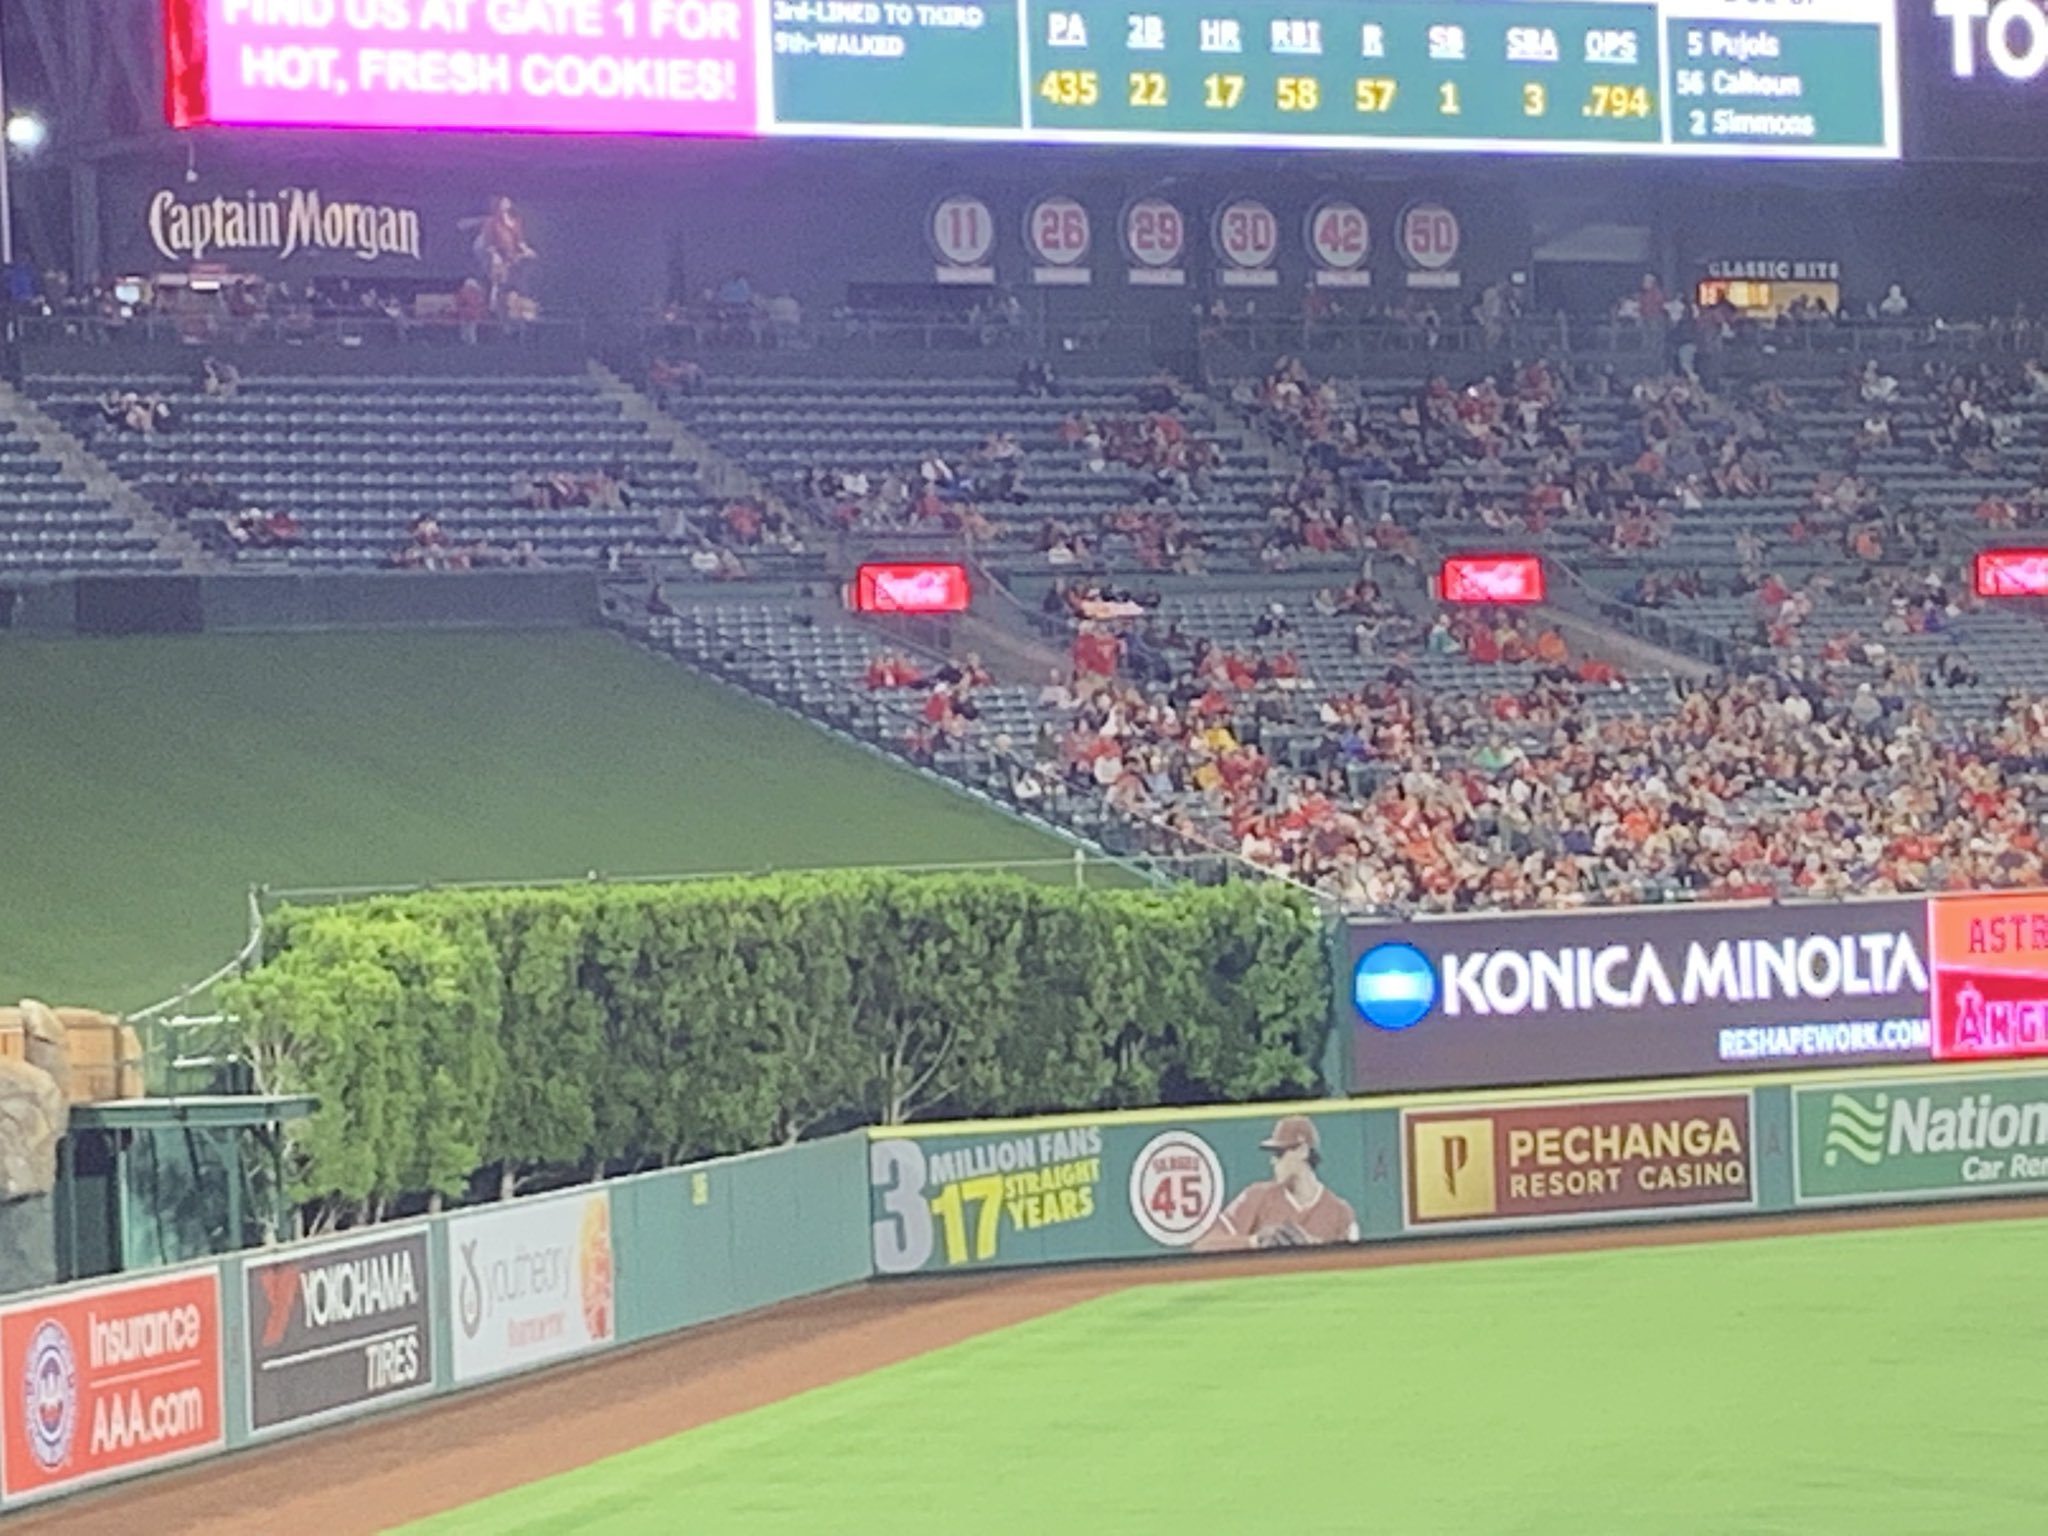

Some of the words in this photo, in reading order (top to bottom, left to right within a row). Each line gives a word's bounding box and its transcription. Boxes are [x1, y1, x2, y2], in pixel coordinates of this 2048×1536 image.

[222, 0, 335, 28] FIND
[345, 0, 411, 32] US
[417, 0, 481, 33] AT
[484, 0, 605, 37] GATE
[613, 2, 636, 40] 1
[650, 2, 741, 41] FOR
[883, 3, 914, 26] TO
[1048, 12, 1087, 45] PA
[1126, 15, 1165, 47] 2B
[1200, 19, 1242, 51] HR
[1270, 20, 1322, 53] RBI
[1362, 23, 1384, 56] R
[1428, 25, 1466, 58] SB
[1506, 27, 1559, 60] SBA
[1584, 30, 1638, 62] OPS
[1688, 31, 1703, 56] 5
[1710, 31, 1780, 61] Pujols
[1933, 0, 2048, 80] TO
[240, 44, 348, 96] HOT,
[357, 48, 510, 95] FRESH
[520, 54, 737, 102] COOKIES!
[1040, 70, 1099, 105] 435
[1129, 72, 1168, 107] 22
[1204, 74, 1245, 108] 17
[1275, 76, 1319, 110] 58
[1355, 78, 1397, 112] 57
[1439, 82, 1461, 115] 1
[1523, 83, 1545, 117] 3
[1581, 84, 1650, 118] .794
[1677, 69, 1705, 95] 56
[1712, 68, 1802, 96] Calhoun
[1690, 109, 1707, 136] 2
[1713, 108, 1816, 137] Simmons
[149, 188, 280, 260] Captain
[279, 187, 420, 261] Morgan
[949, 206, 979, 249] 11
[1040, 209, 1085, 250] 26
[1135, 210, 1179, 250] 29
[1228, 211, 1271, 252] 30
[1320, 212, 1363, 252] 42
[1411, 214, 1453, 254] 50
[1442, 942, 1676, 1015] KONICA
[1680, 931, 1929, 1003] MINOLTA
[1719, 1017, 1931, 1060] RESHAPEWORK.COM
[1508, 1117, 1742, 1168] PECHANGA
[1510, 1167, 1622, 1199] RESORT
[1637, 1160, 1746, 1192] CASINO
[1961, 1155, 2004, 1182] Car
[870, 1138, 933, 1274] 3
[929, 1142, 1036, 1186] MILLION
[1038, 1124, 1102, 1164] FANS
[931, 1174, 1003, 1266] 17
[1004, 1157, 1101, 1199] STRAIGHT
[1006, 1186, 1095, 1232] YEARS
[1151, 1175, 1202, 1219] 45
[300, 1250, 418, 1328] YOKOHAMA
[88, 1303, 200, 1369] Insurance
[365, 1334, 419, 1391] TIRES
[90, 1387, 204, 1456] AAA.com
